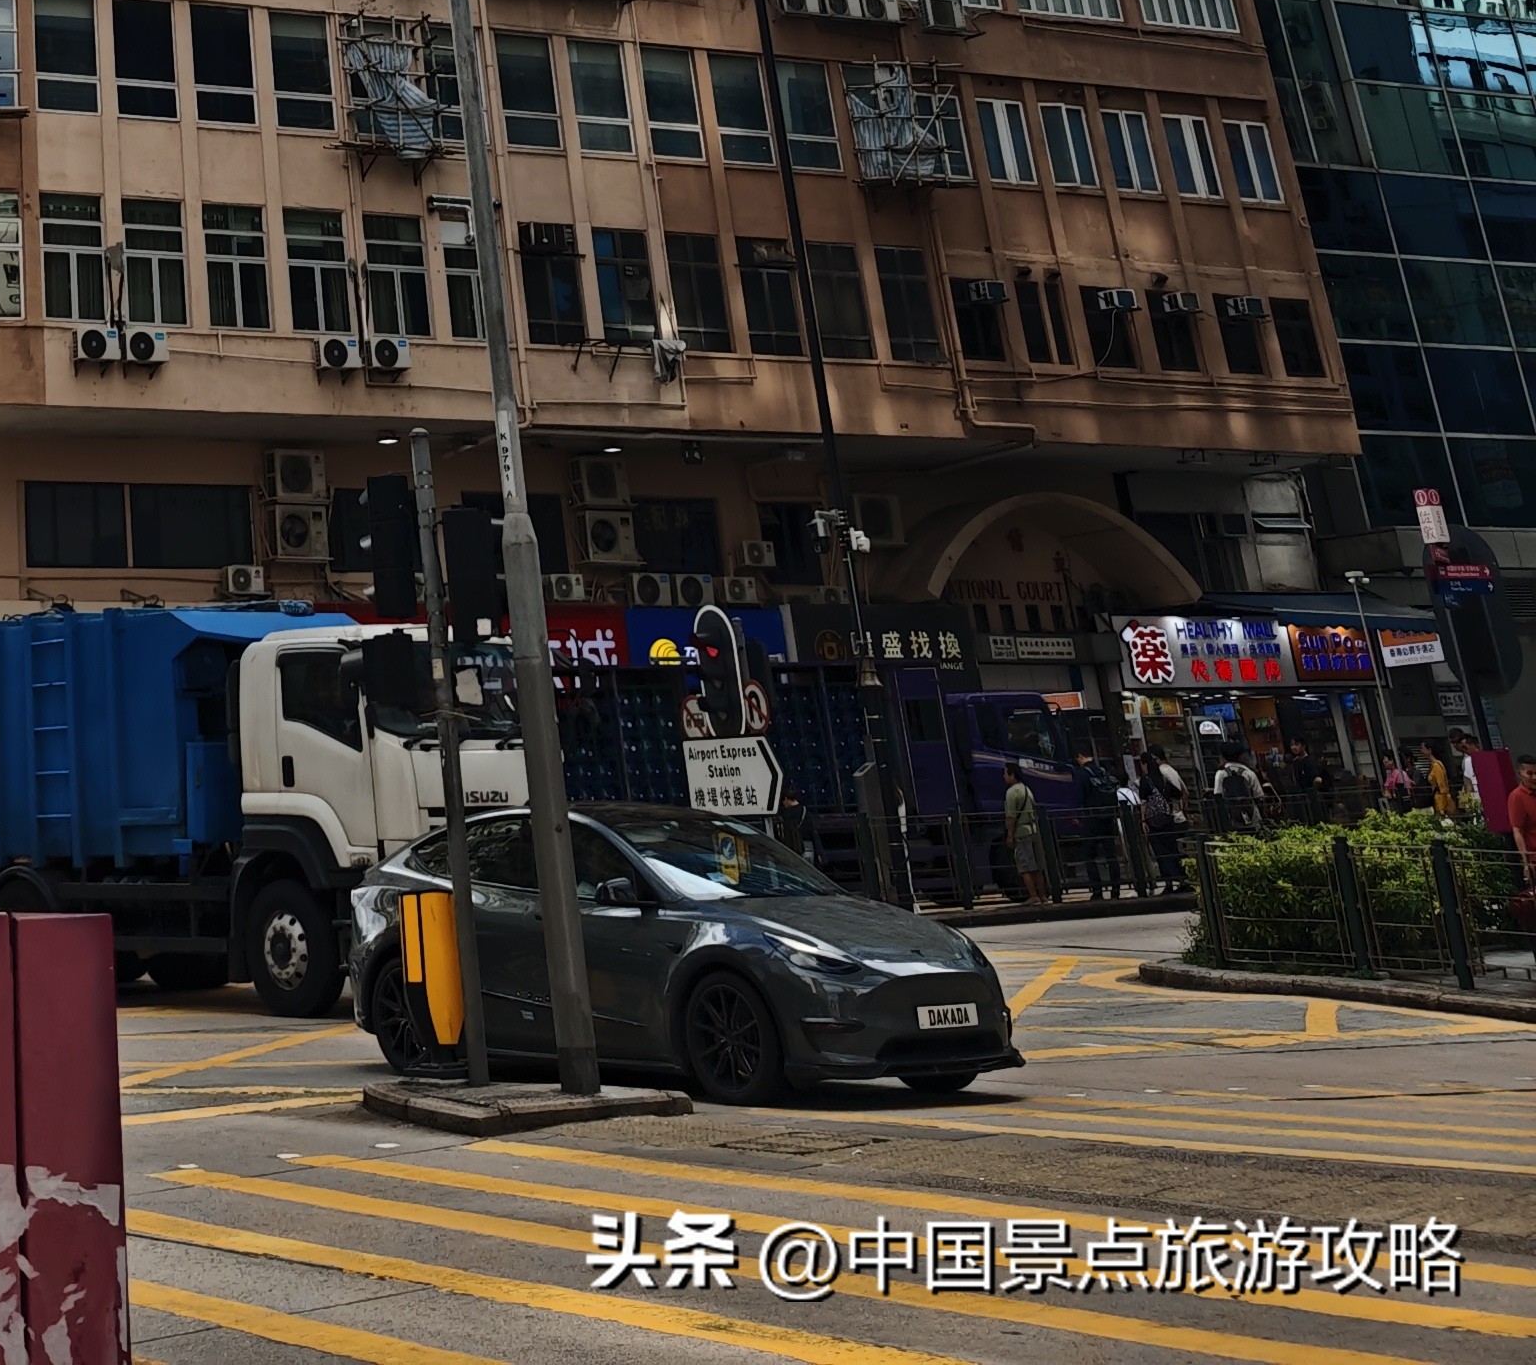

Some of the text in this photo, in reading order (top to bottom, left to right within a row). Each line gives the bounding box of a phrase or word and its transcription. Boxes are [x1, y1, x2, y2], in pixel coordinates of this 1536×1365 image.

[1175, 621, 1278, 640] HEALTHY MALL
[1296, 631, 1328, 652] Sun
[688, 745, 757, 761] Airport Express
[708, 764, 741, 778] Station
[465, 790, 509, 803] ISUZU
[928, 1006, 971, 1028] DAKADA
